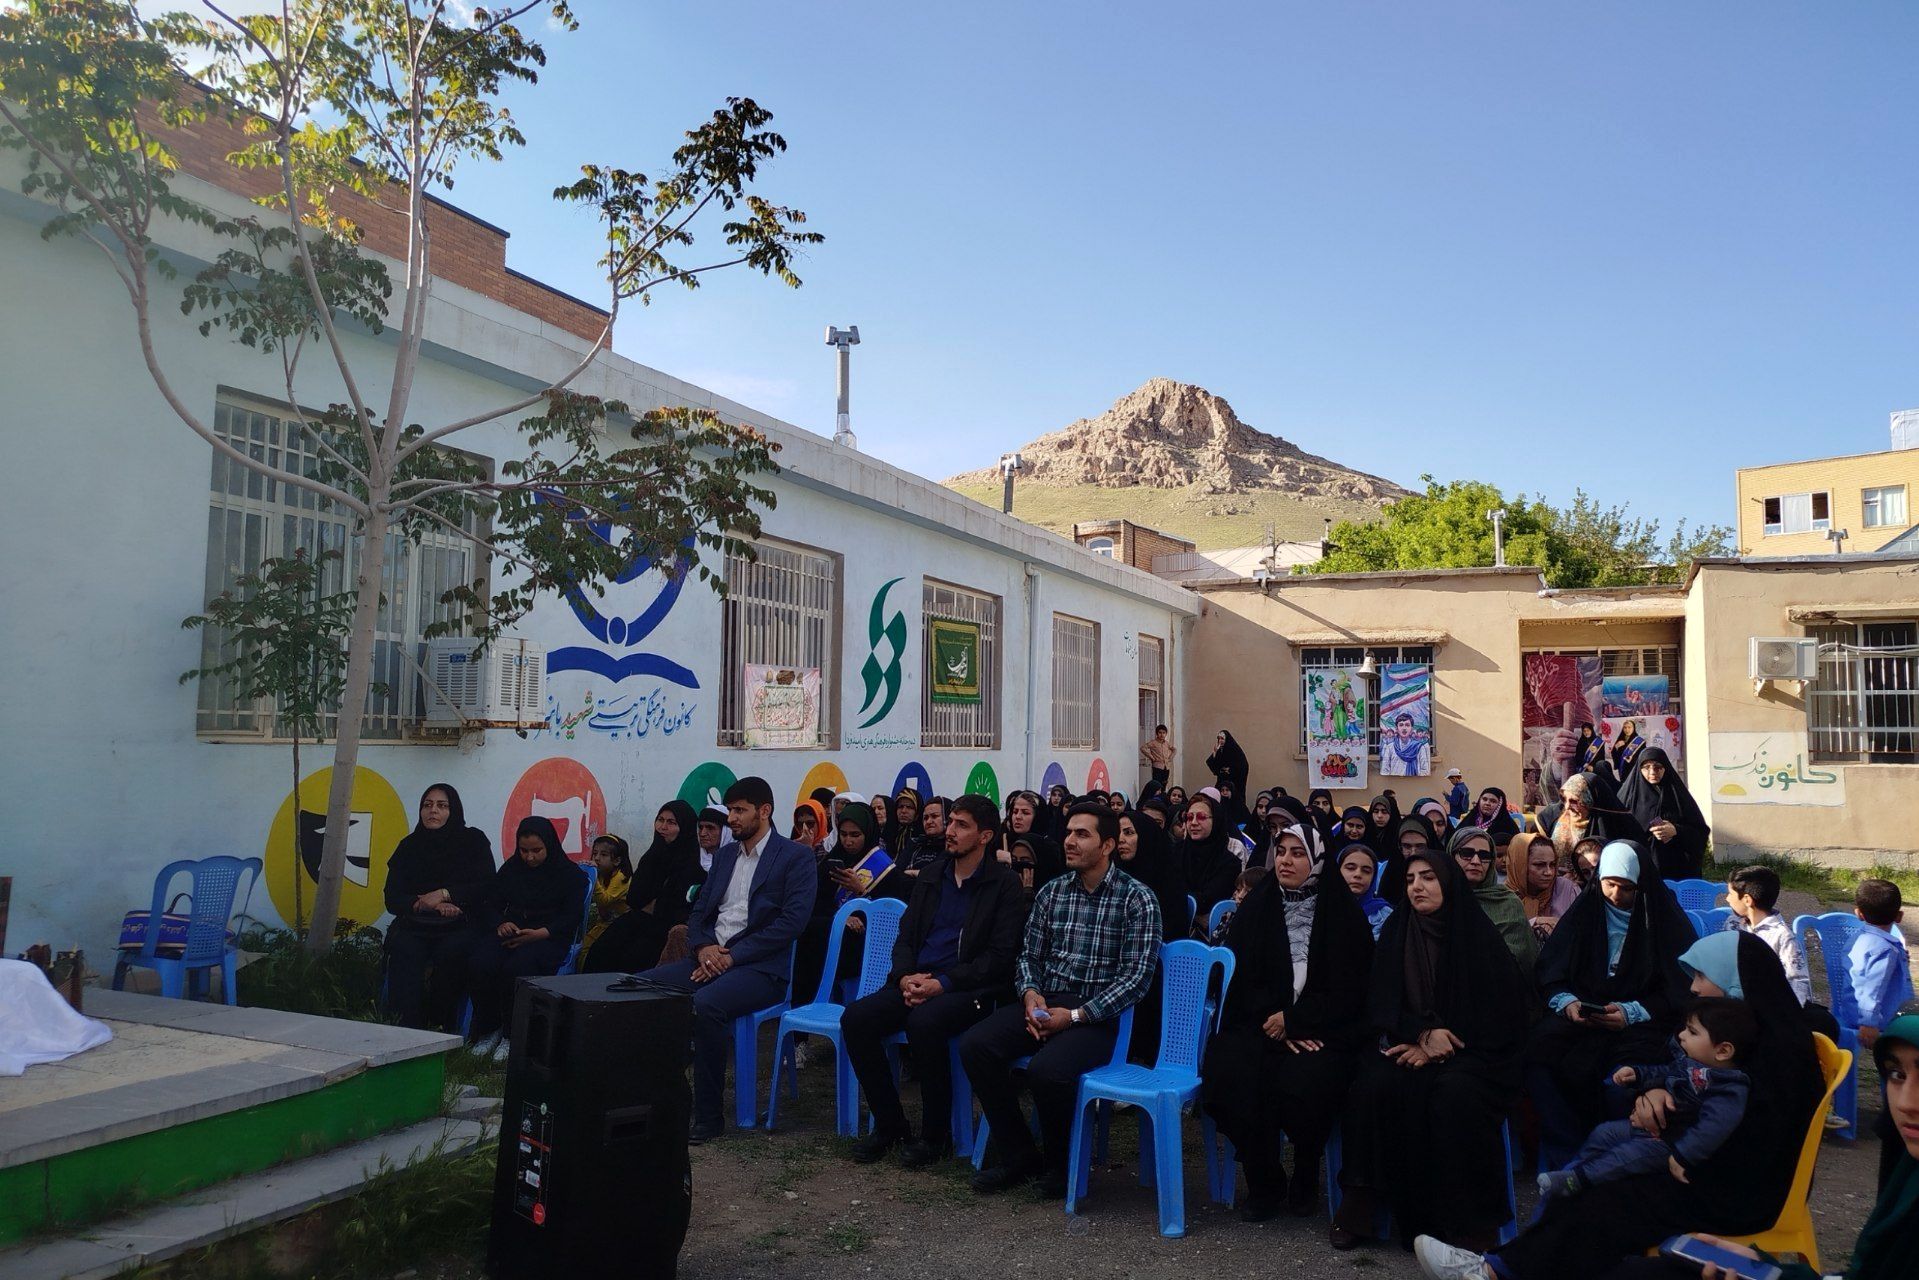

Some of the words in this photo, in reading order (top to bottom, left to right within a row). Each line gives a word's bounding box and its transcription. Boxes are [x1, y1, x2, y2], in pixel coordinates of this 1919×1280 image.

[560, 688, 595, 741] شهید
[588, 694, 647, 741] تربیتی
[636, 687, 668, 738] فرهنگی
[662, 701, 698, 735] کانون
[1713, 735, 1772, 776] فدک
[1758, 753, 1837, 792] کانون
